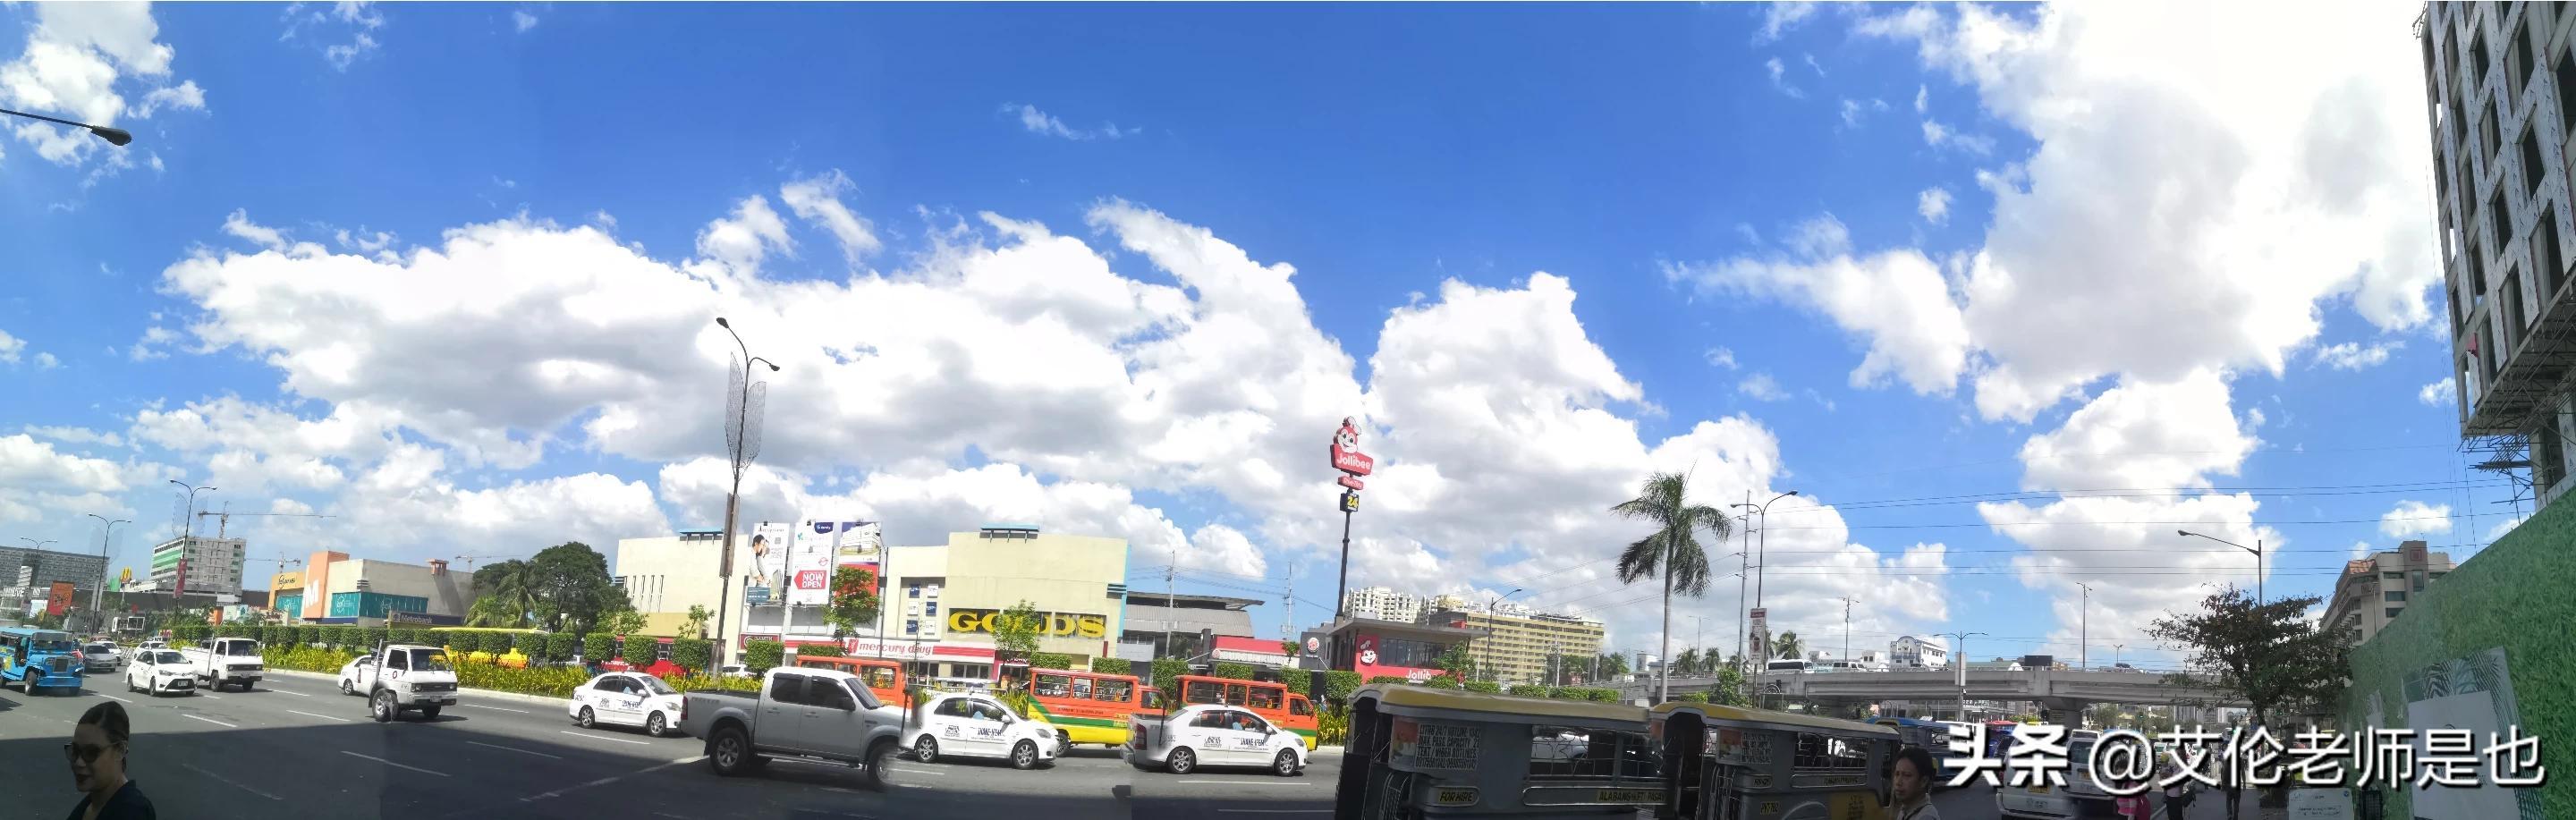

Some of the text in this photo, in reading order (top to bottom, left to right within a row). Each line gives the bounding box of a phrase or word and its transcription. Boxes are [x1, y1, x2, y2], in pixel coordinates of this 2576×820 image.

[1336, 453, 1371, 470] Jollibee
[1347, 495, 1359, 508] 24
[802, 572, 825, 581] NOW
[801, 580, 823, 588] OPEN
[401, 614, 433, 624] Metrobank
[859, 643, 906, 654] mercury
[1405, 669, 1432, 681] Jollib
[1439, 791, 1474, 802] FOR HIRE
[1598, 790, 1631, 801] ALABANG
